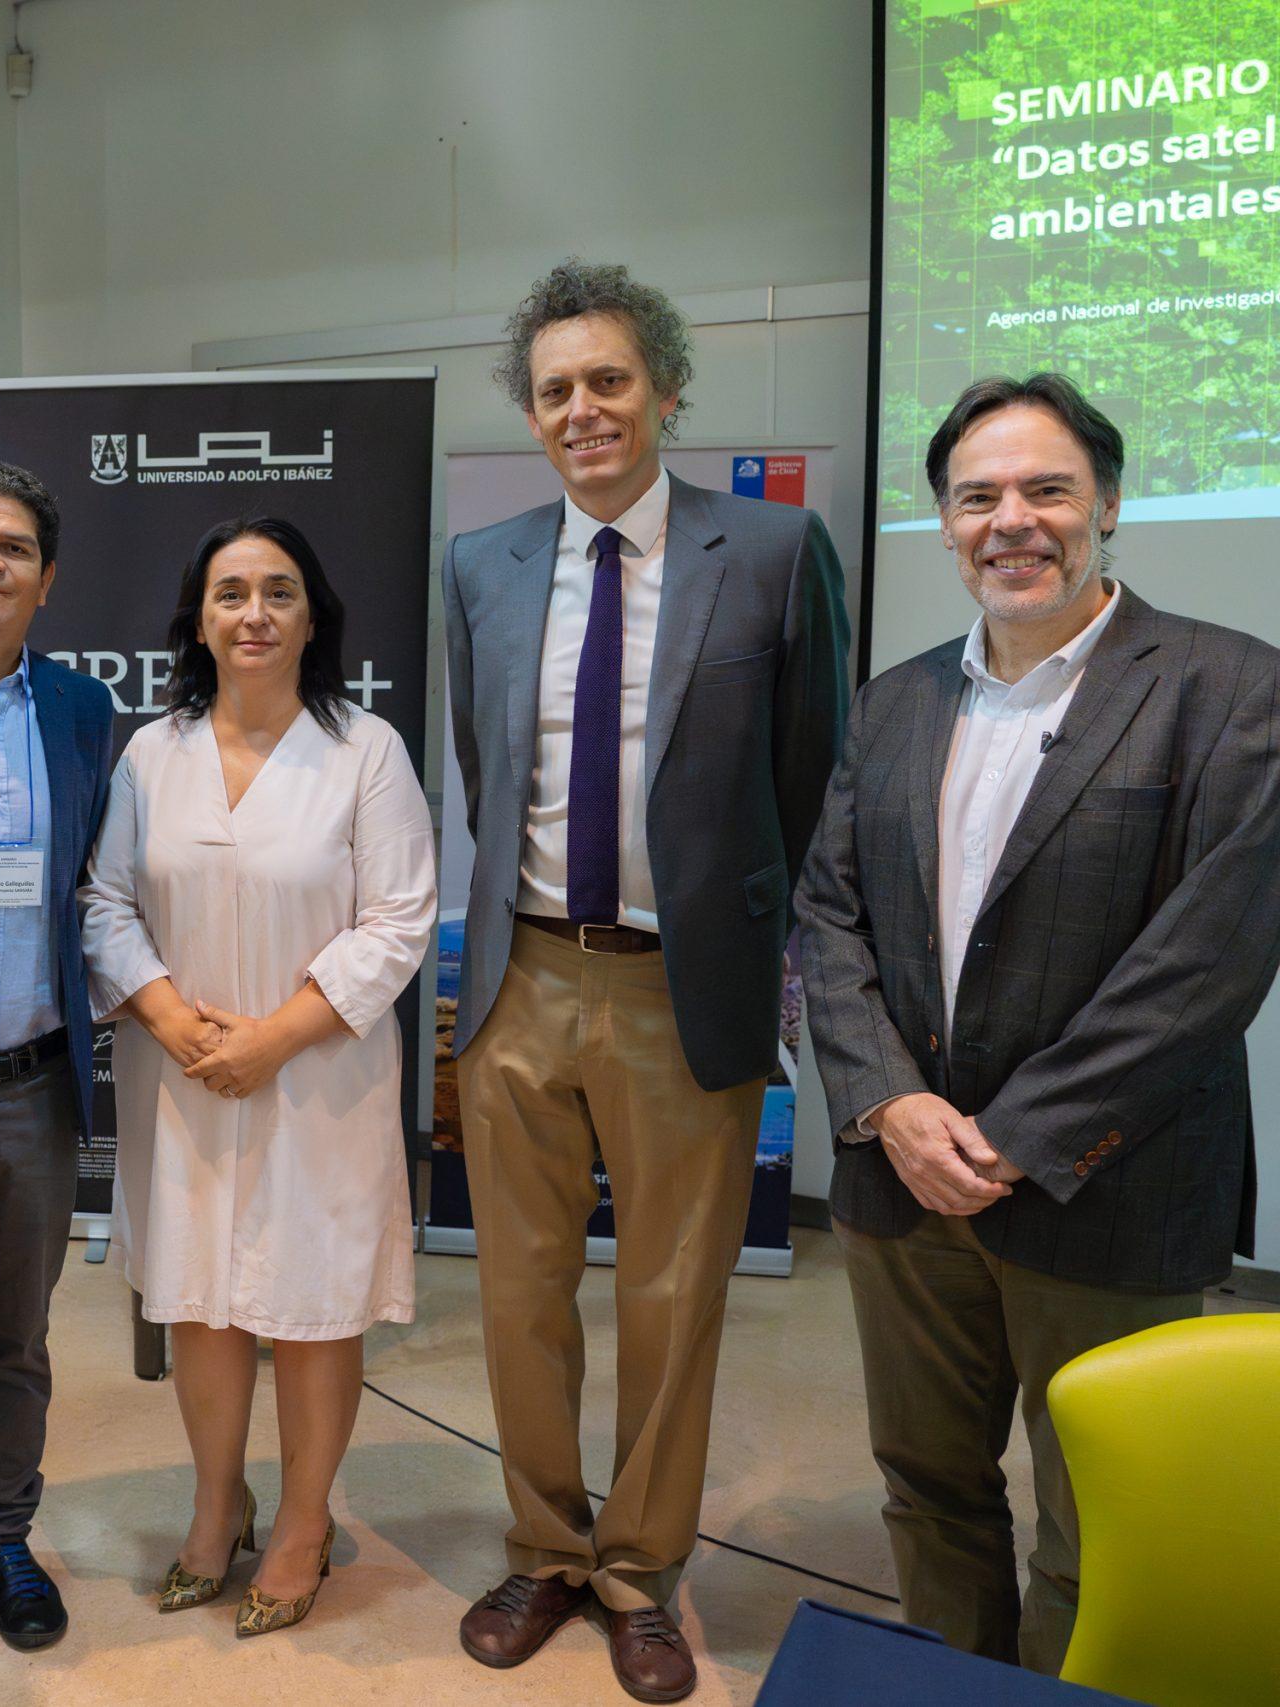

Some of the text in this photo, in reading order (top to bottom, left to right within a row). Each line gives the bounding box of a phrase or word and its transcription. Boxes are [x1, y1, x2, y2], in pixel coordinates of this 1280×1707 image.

[991, 58, 1270, 126] SEMINARIO
[1161, 114, 1276, 163] satel
[989, 180, 1280, 241] ambientales
[986, 309, 1057, 330] Agencia
[1061, 299, 1140, 321] Nacional
[1146, 296, 1170, 314] de
[137, 466, 334, 484] UNIVERSIDAD ADOLFO IBÁÑEZ
[779, 467, 799, 475] Chile
